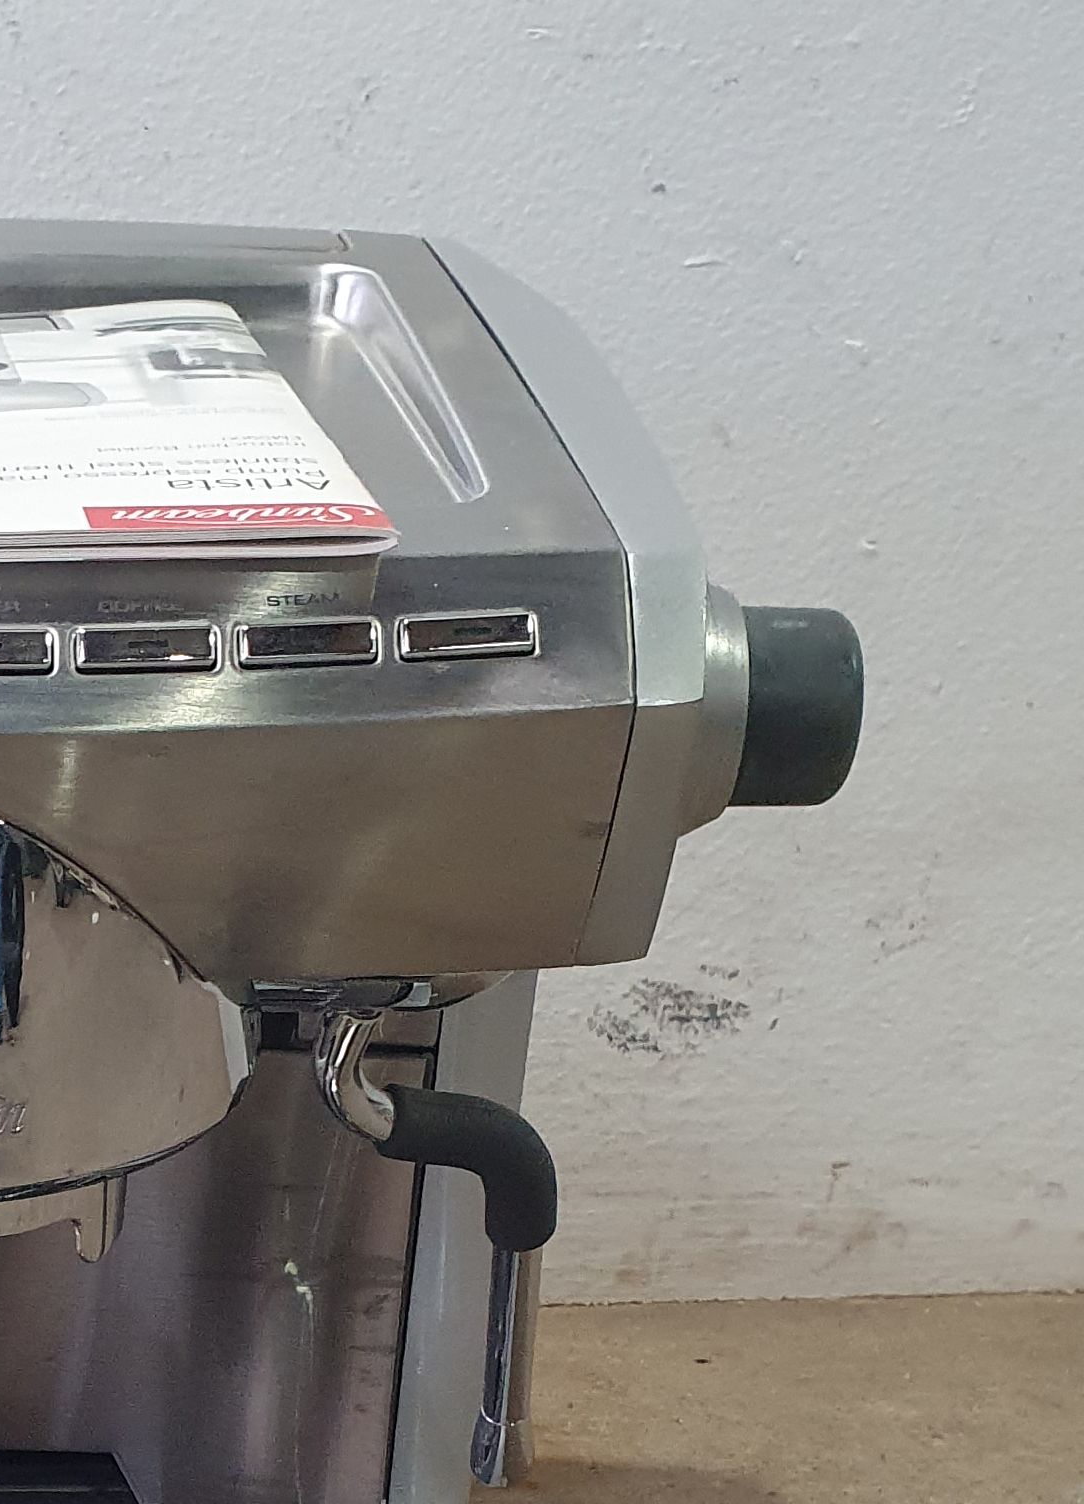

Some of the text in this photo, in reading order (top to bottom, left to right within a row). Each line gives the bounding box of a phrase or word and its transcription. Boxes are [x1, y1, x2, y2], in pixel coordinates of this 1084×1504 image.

[88, 460, 164, 469] steel
[175, 457, 319, 466] stainless
[65, 468, 212, 478] espresso
[224, 466, 327, 478] Pump
[168, 478, 331, 491] Artista
[111, 505, 375, 524] Sunbeam
[266, 592, 340, 607] STEAM
